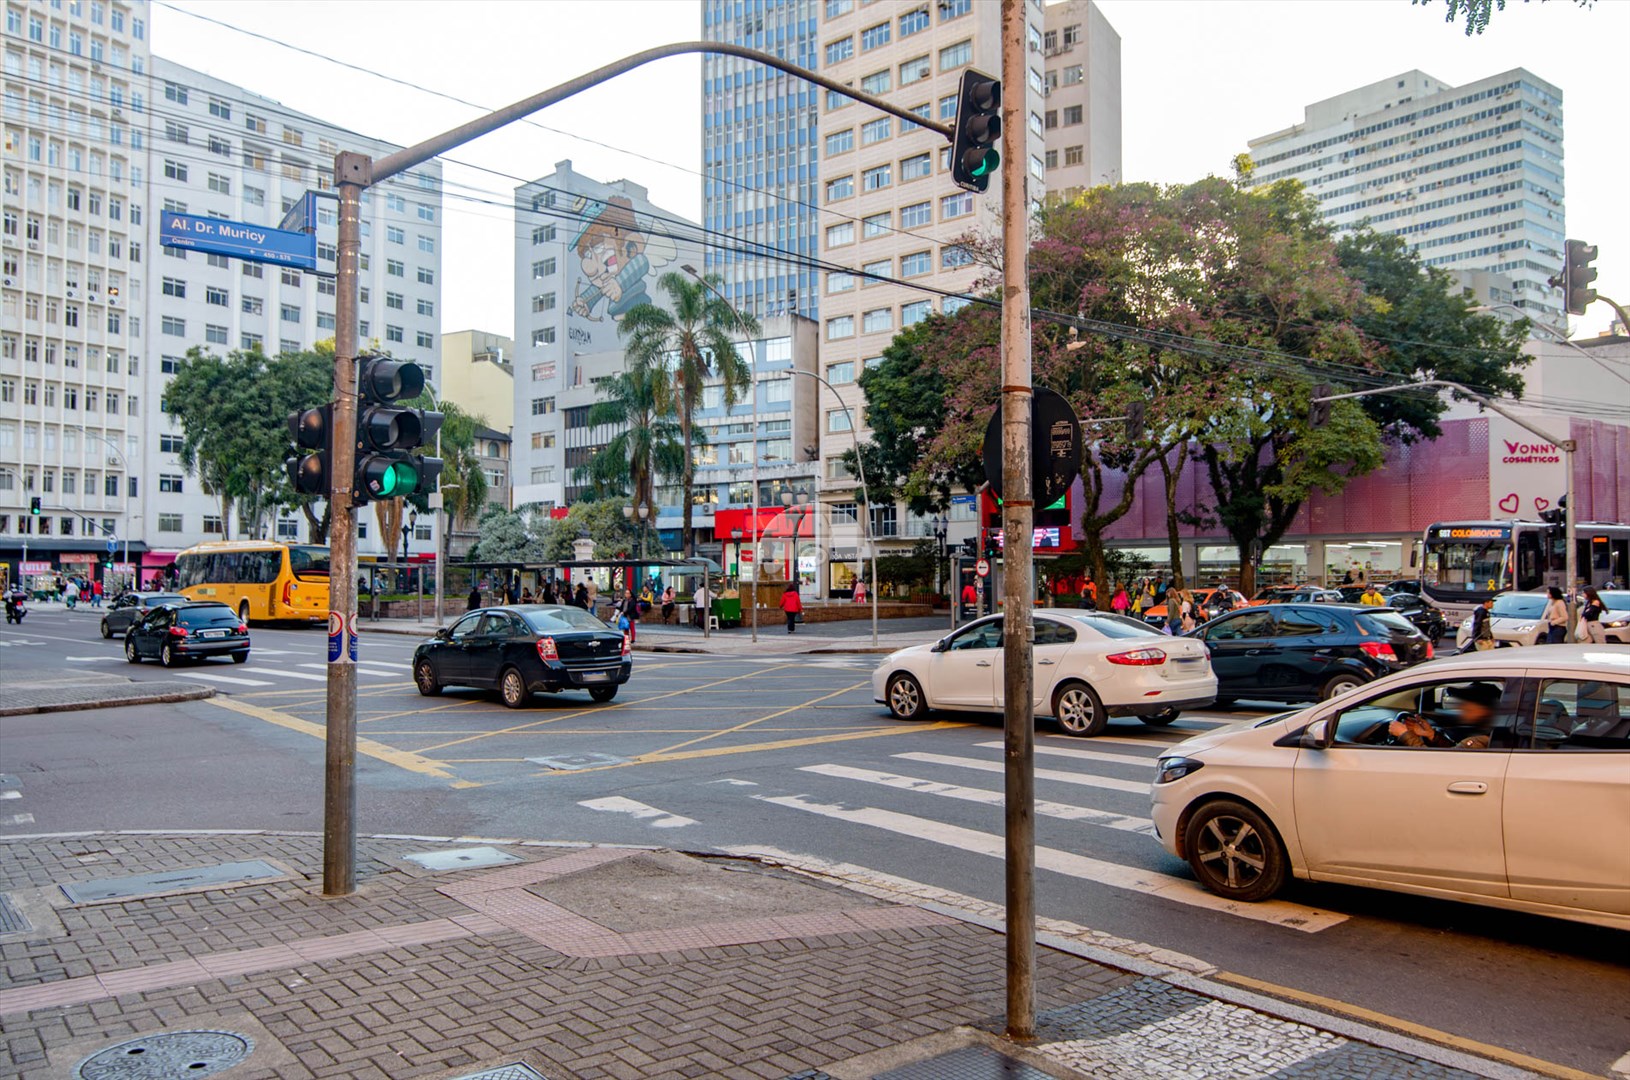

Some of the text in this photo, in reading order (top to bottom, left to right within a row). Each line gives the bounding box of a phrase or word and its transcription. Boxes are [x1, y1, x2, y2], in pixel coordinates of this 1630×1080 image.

[171, 218, 266, 244] Al. Dr. Muricy
[172, 237, 196, 246] Centro
[1503, 439, 1557, 454] VONNY
[1502, 455, 1560, 463] COSMÉTICOS
[1451, 529, 1503, 538] COLOMBO/CIC
